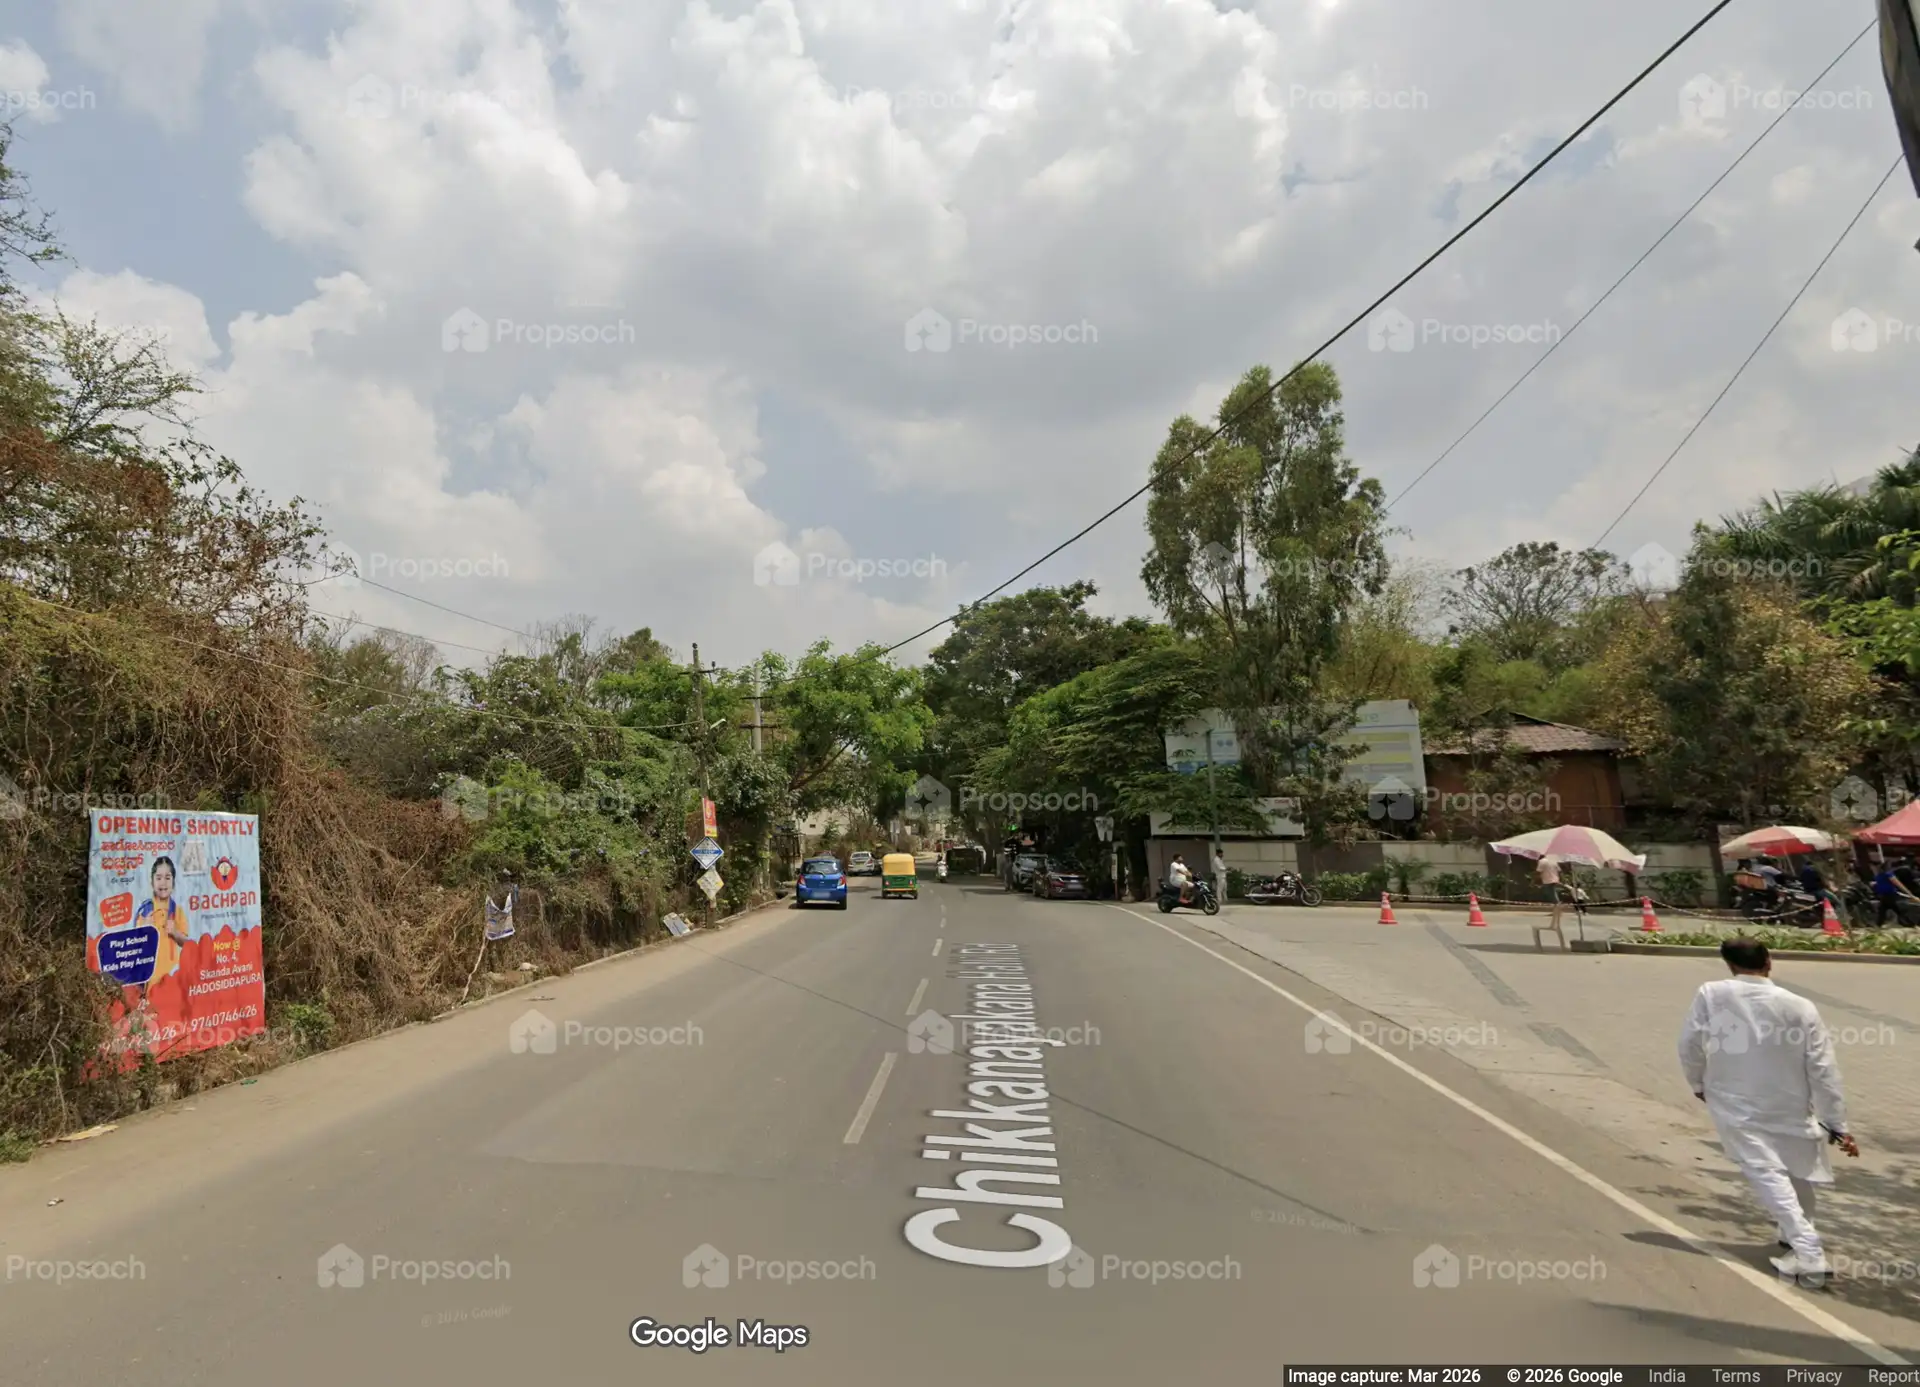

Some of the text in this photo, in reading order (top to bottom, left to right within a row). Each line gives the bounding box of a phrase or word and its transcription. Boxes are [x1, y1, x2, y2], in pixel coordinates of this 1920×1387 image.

[98, 815, 255, 836] OPENING SHORTLY
[109, 935, 148, 949] Play School
[213, 941, 231, 952] Now
[115, 948, 143, 959] Daycare
[216, 954, 230, 964] No.
[103, 956, 155, 972] Kids Play Arena
[200, 962, 254, 980] Skanda Avani
[191, 1003, 257, 1031] 9740746426
